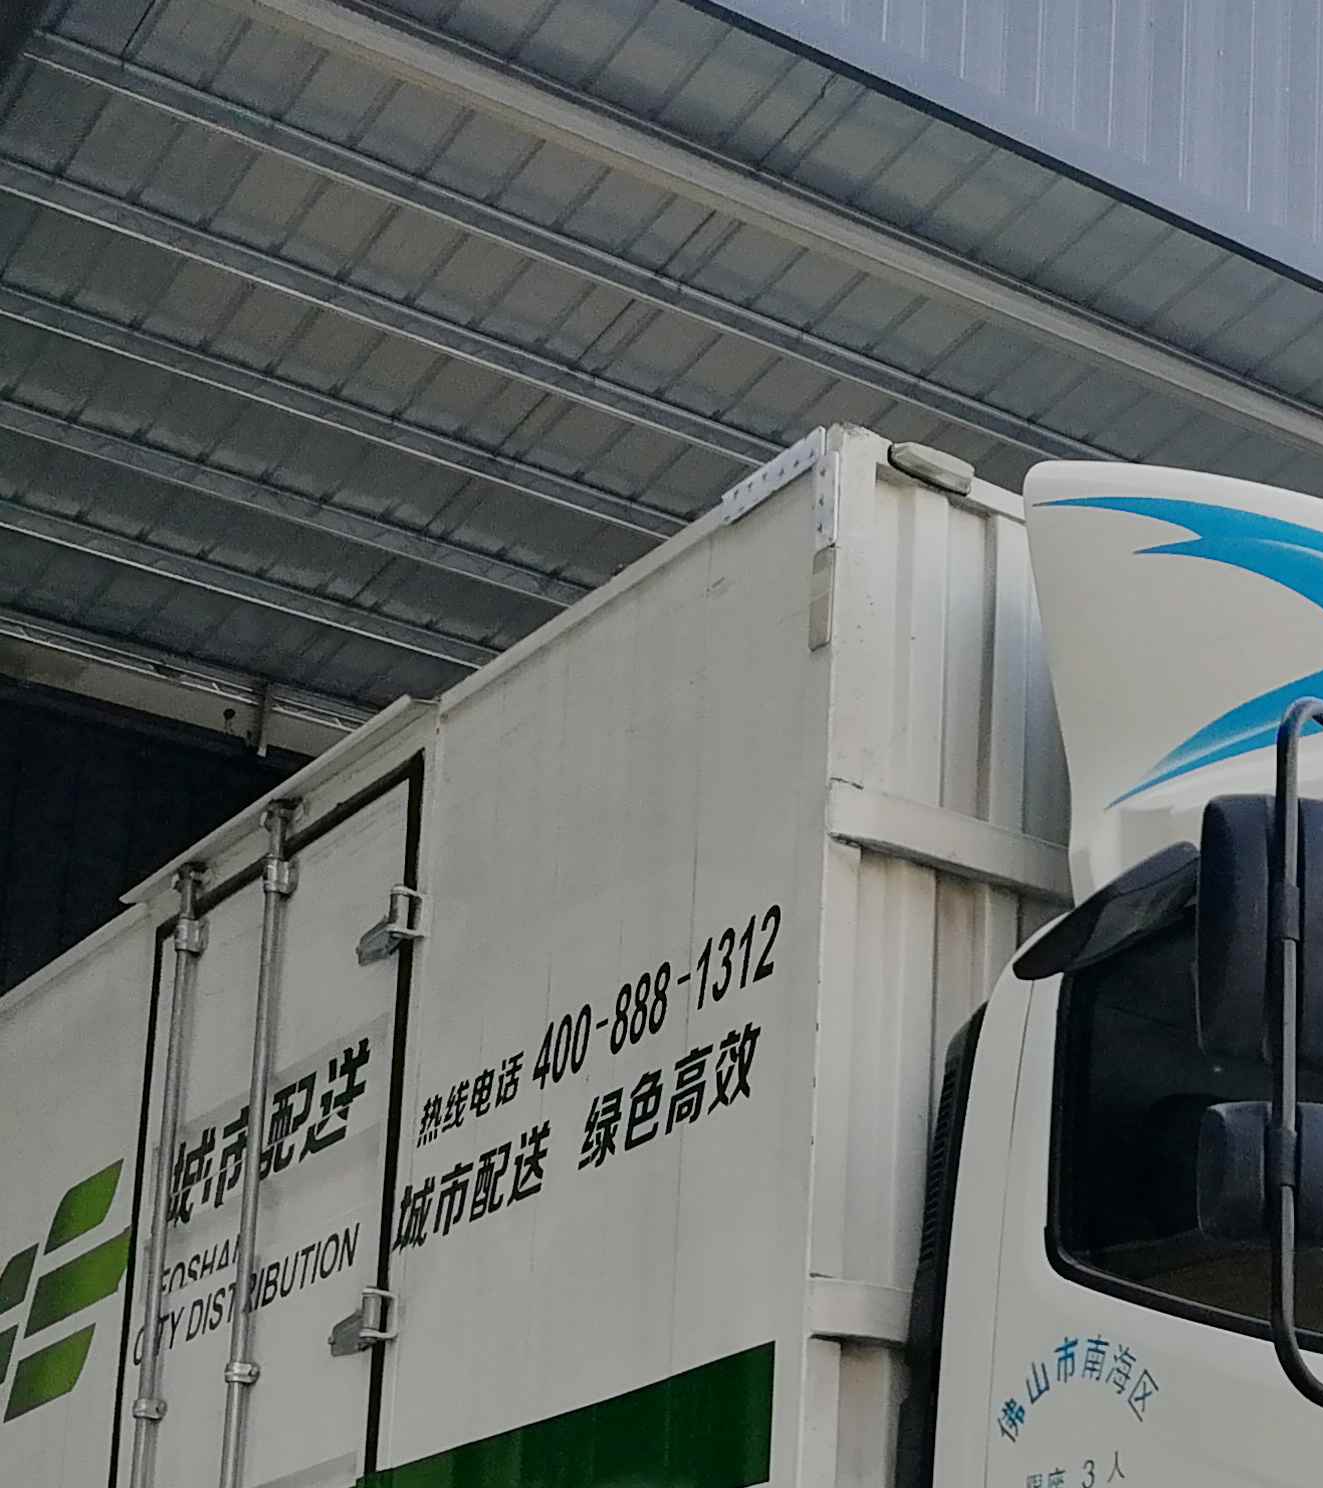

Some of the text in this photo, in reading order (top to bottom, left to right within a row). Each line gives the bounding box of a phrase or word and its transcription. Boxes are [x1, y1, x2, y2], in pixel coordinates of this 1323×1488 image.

[392, 1022, 761, 1254] 城市配送 绿色高效
[416, 904, 781, 1147] 热线电话 400-888-1312
[1106, 1450, 1126, 1484] 人
